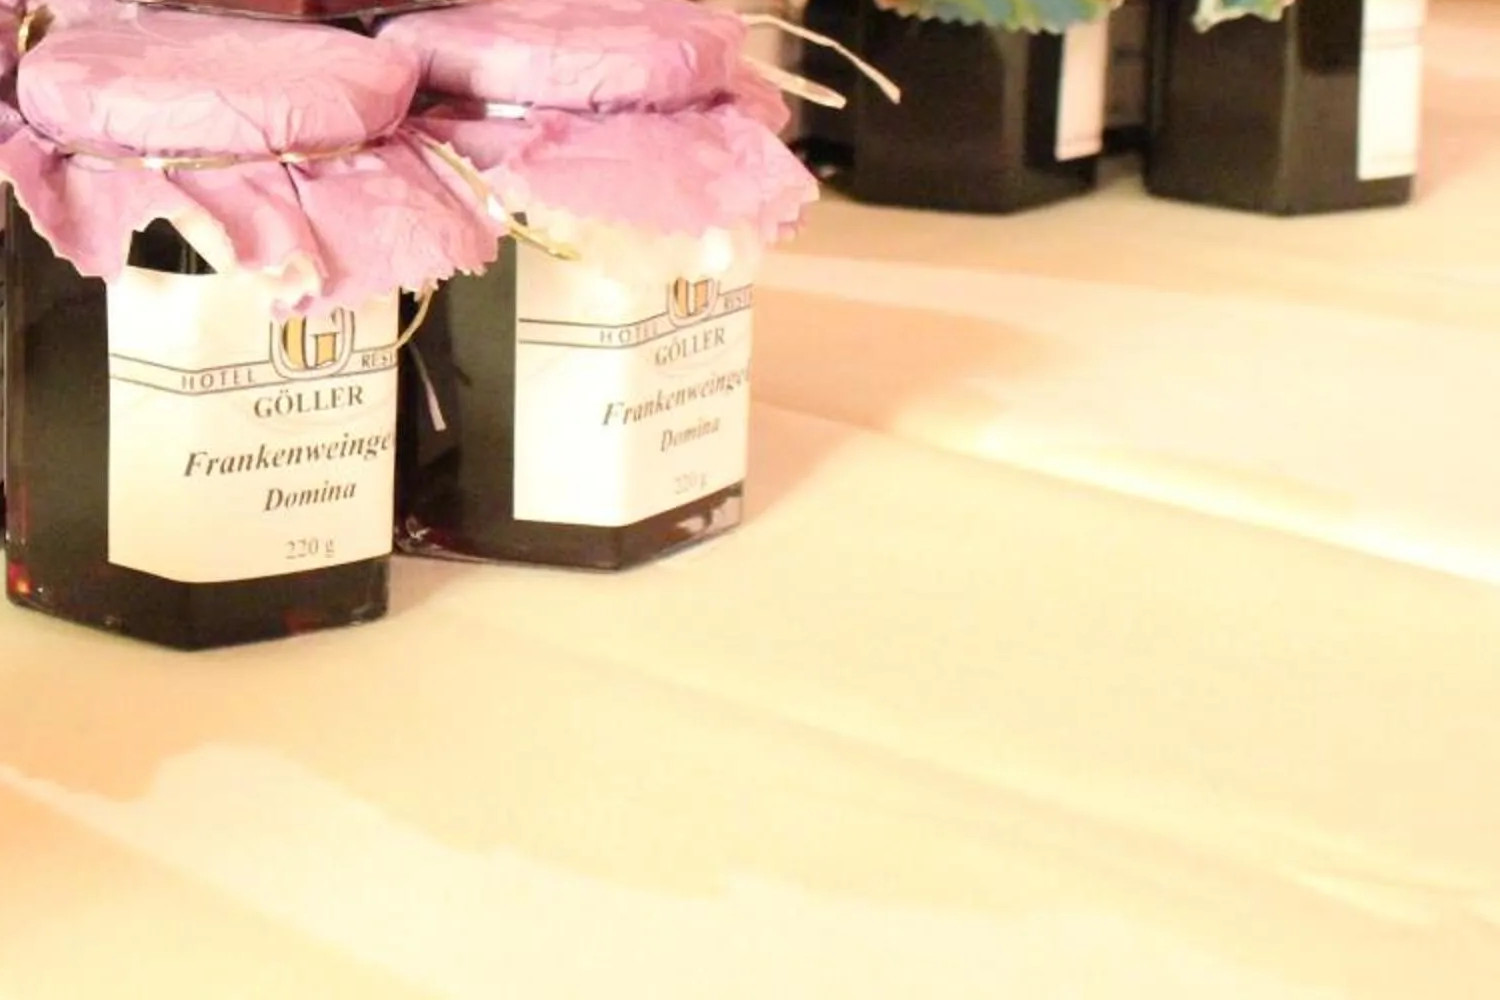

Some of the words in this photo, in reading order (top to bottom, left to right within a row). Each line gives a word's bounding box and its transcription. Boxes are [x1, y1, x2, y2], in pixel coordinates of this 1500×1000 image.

[600, 324, 661, 344] HOTEL
[655, 326, 726, 367] GÖLLER
[181, 368, 256, 391] HOTEL
[254, 384, 364, 419] GÖLLER
[660, 415, 721, 452] Domina
[263, 479, 357, 512] Domina
[286, 537, 319, 560] 220
